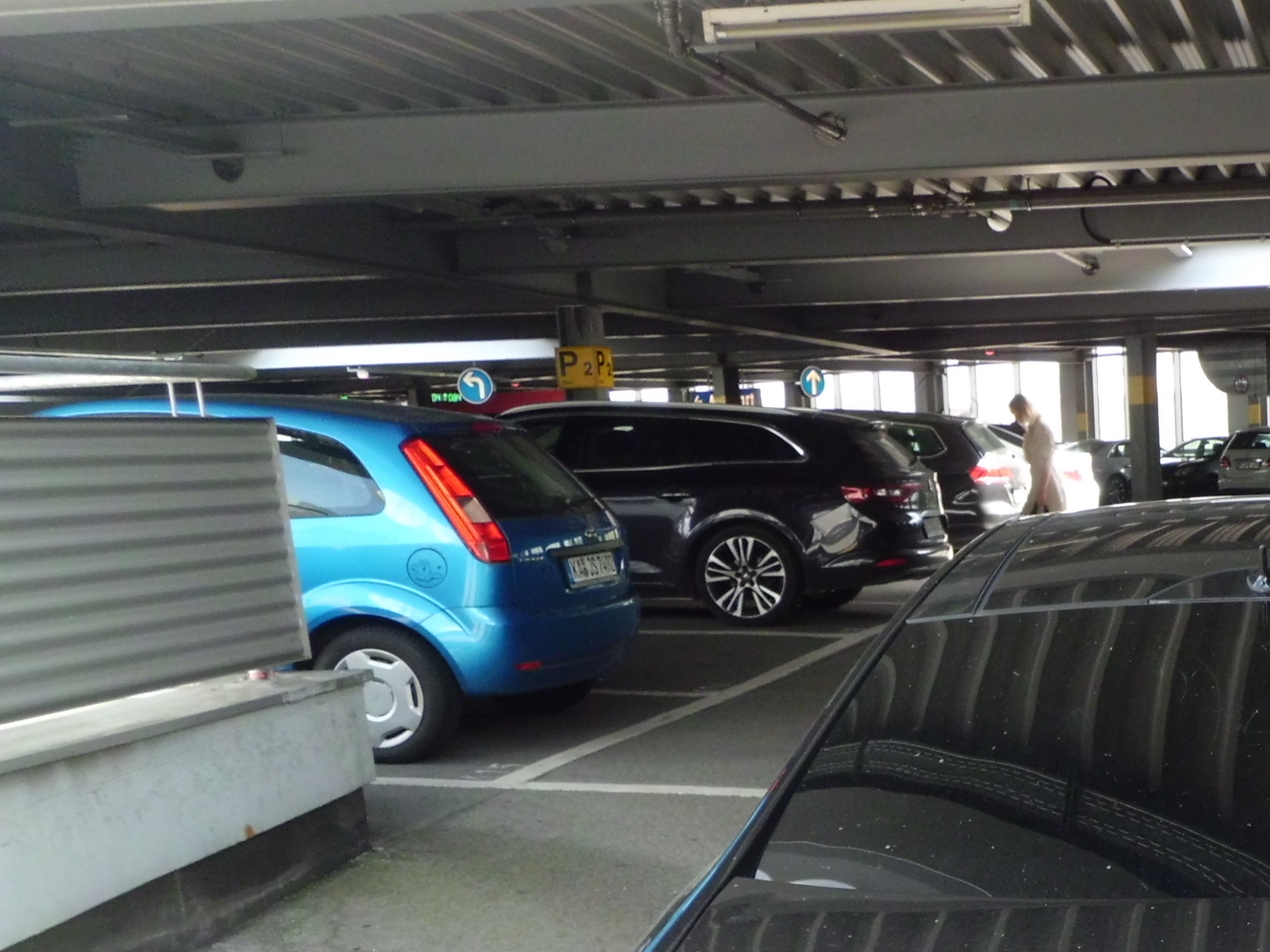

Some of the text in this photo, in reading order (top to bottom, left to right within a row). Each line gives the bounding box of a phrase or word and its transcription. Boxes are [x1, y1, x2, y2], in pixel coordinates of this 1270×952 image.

[559, 350, 593, 377] P 2
[596, 350, 613, 377] P 2
